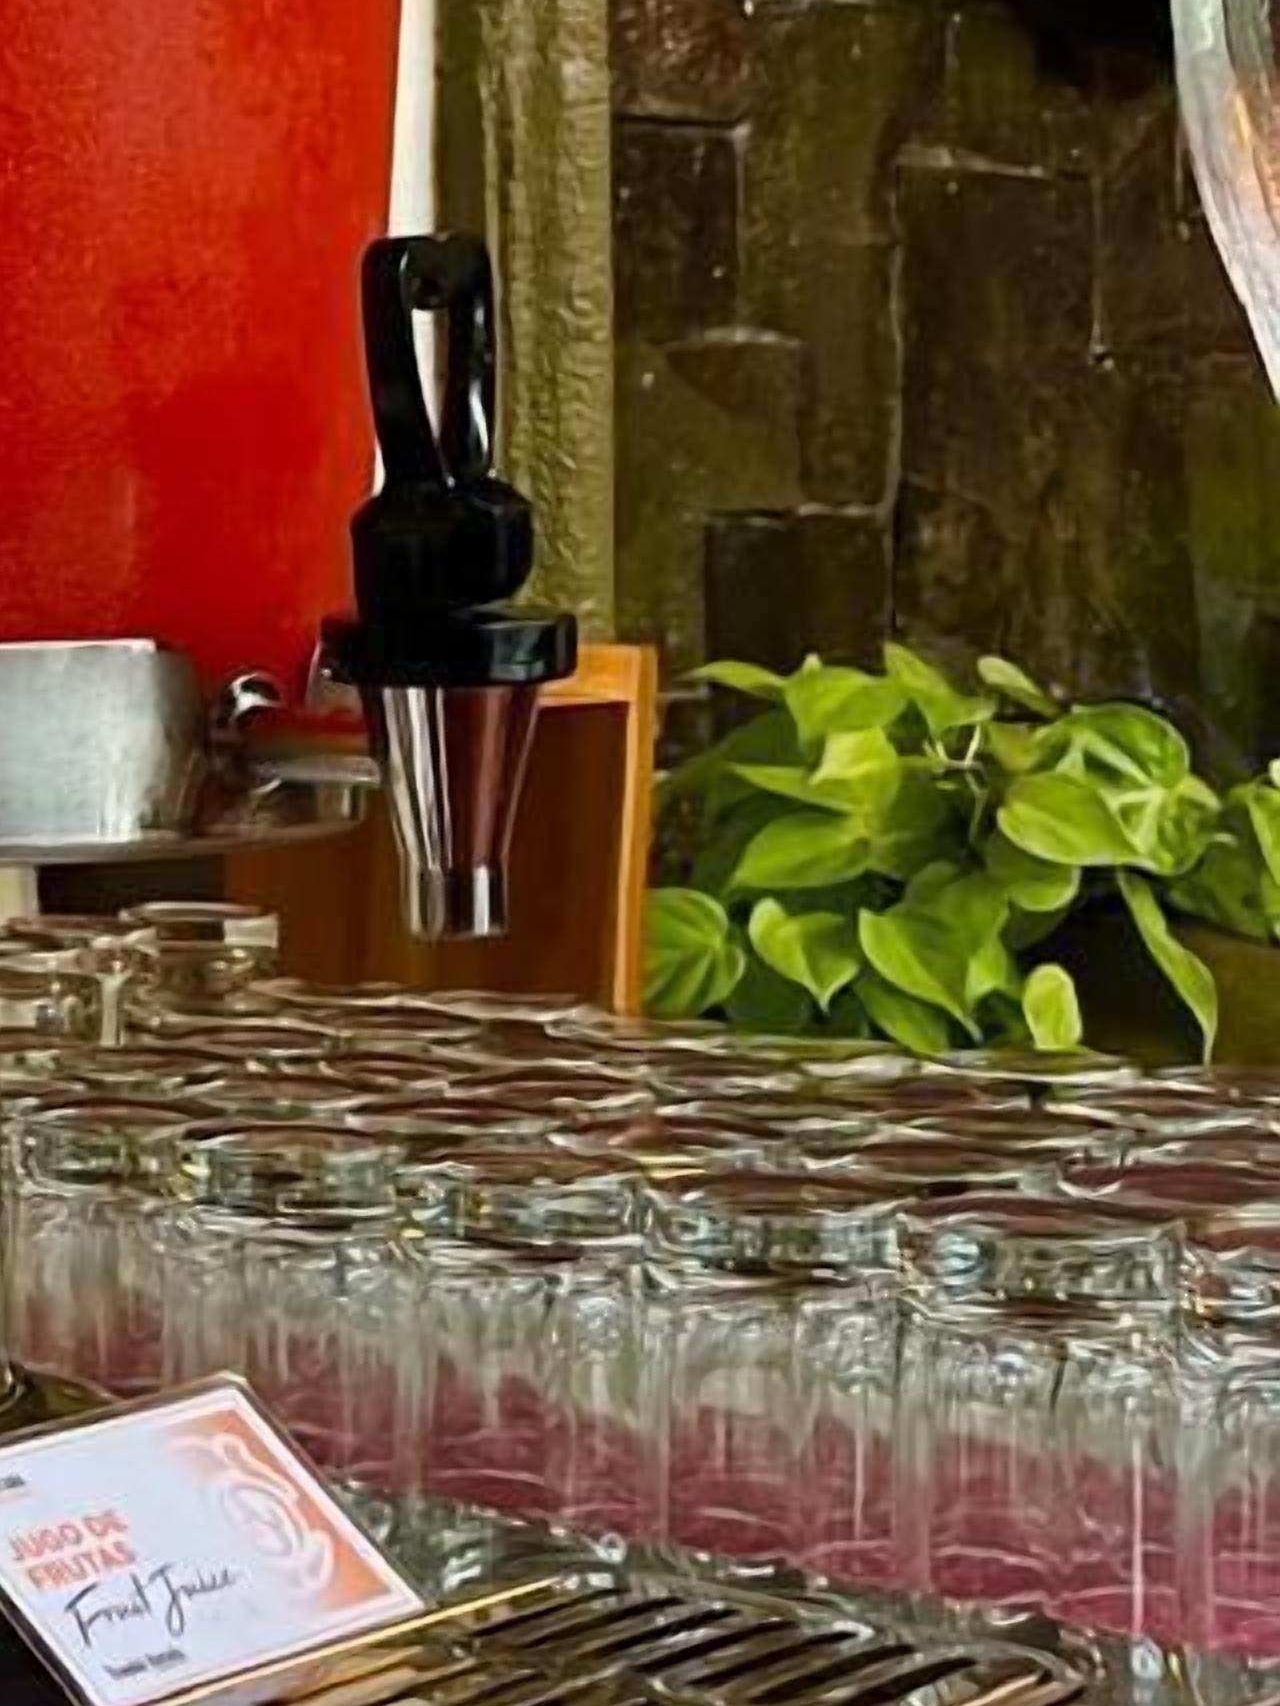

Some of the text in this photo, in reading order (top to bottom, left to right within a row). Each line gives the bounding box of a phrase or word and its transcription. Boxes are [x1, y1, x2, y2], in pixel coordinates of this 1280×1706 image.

[9, 1509, 129, 1561] JUGO DE
[28, 1540, 137, 1590] FRUTAS
